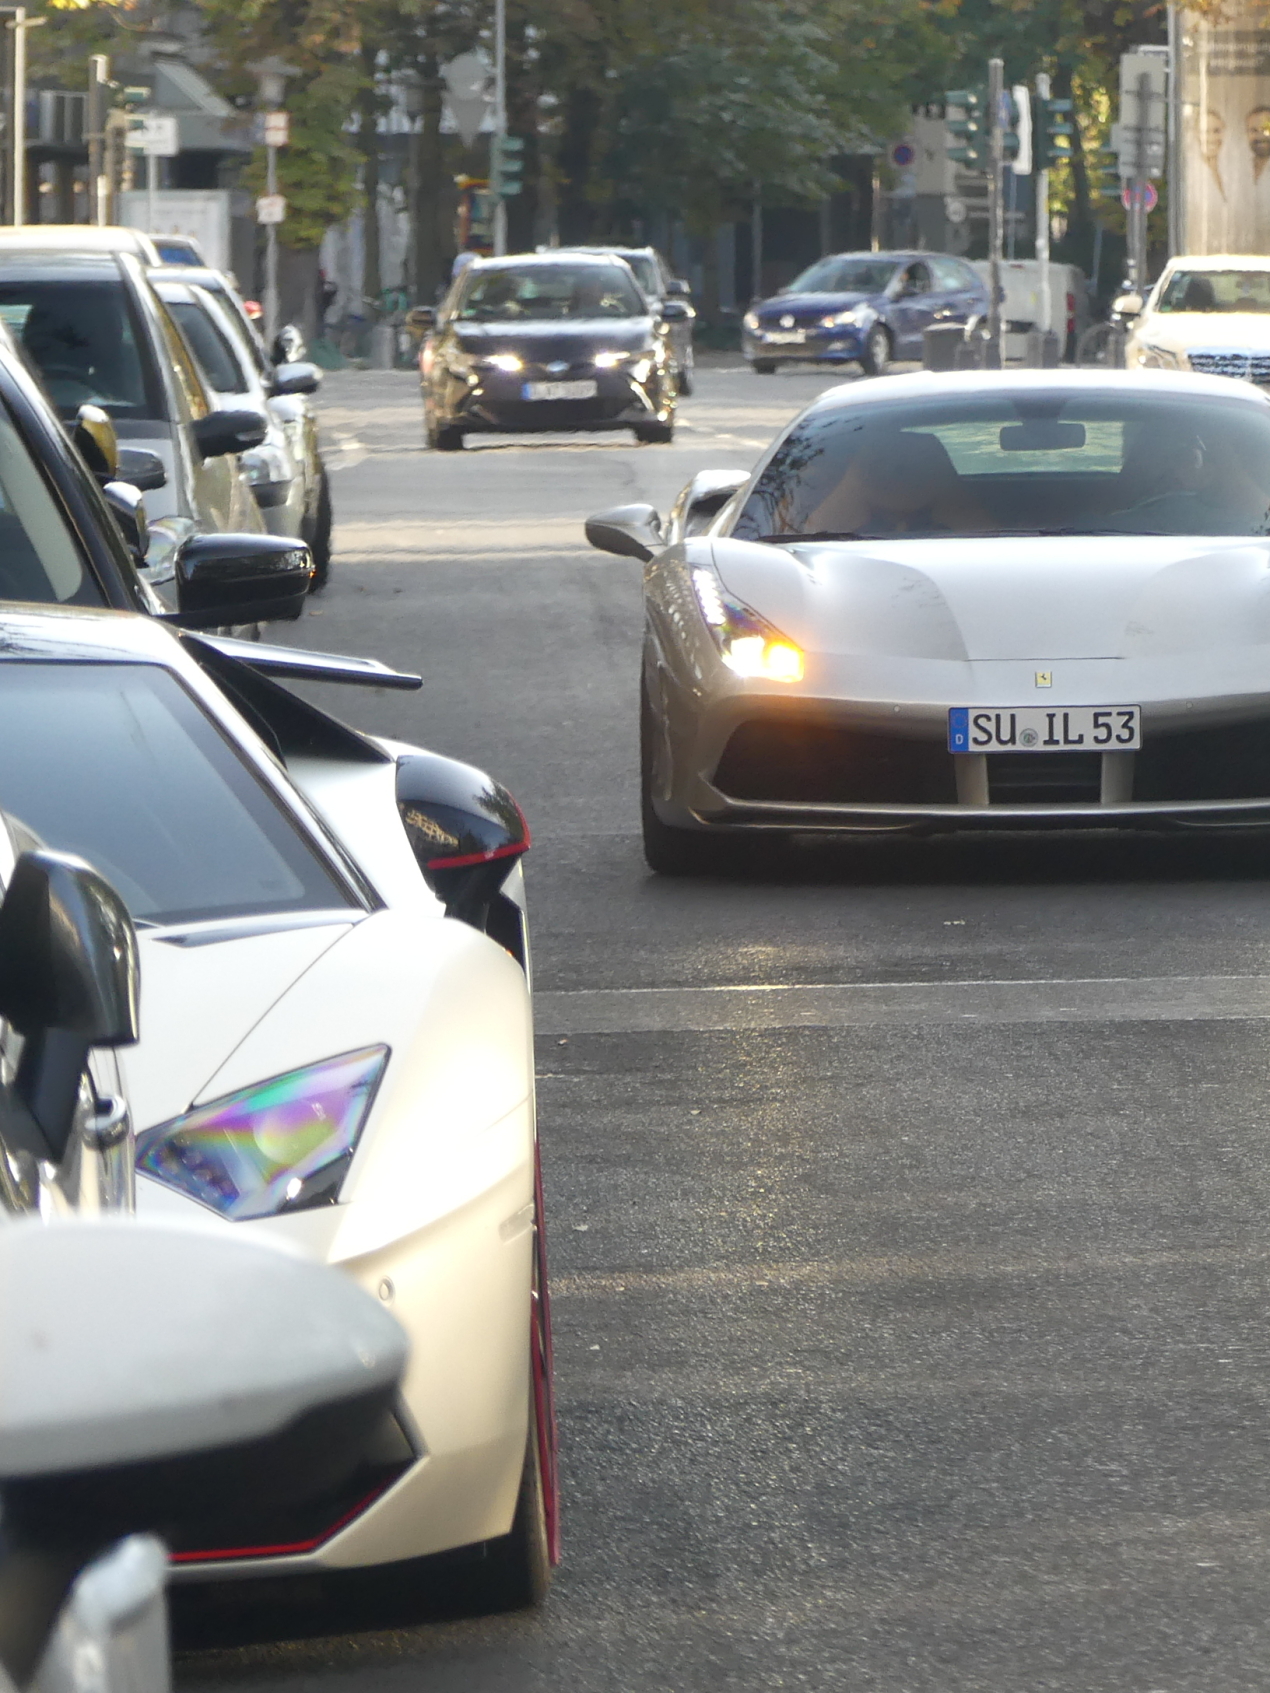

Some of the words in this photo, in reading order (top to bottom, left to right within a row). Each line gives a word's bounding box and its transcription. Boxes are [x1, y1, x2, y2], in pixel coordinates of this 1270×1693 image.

[955, 734, 964, 744] D
[972, 713, 1016, 746] SU
[1043, 712, 1084, 745] IL
[1093, 711, 1135, 744] 53
